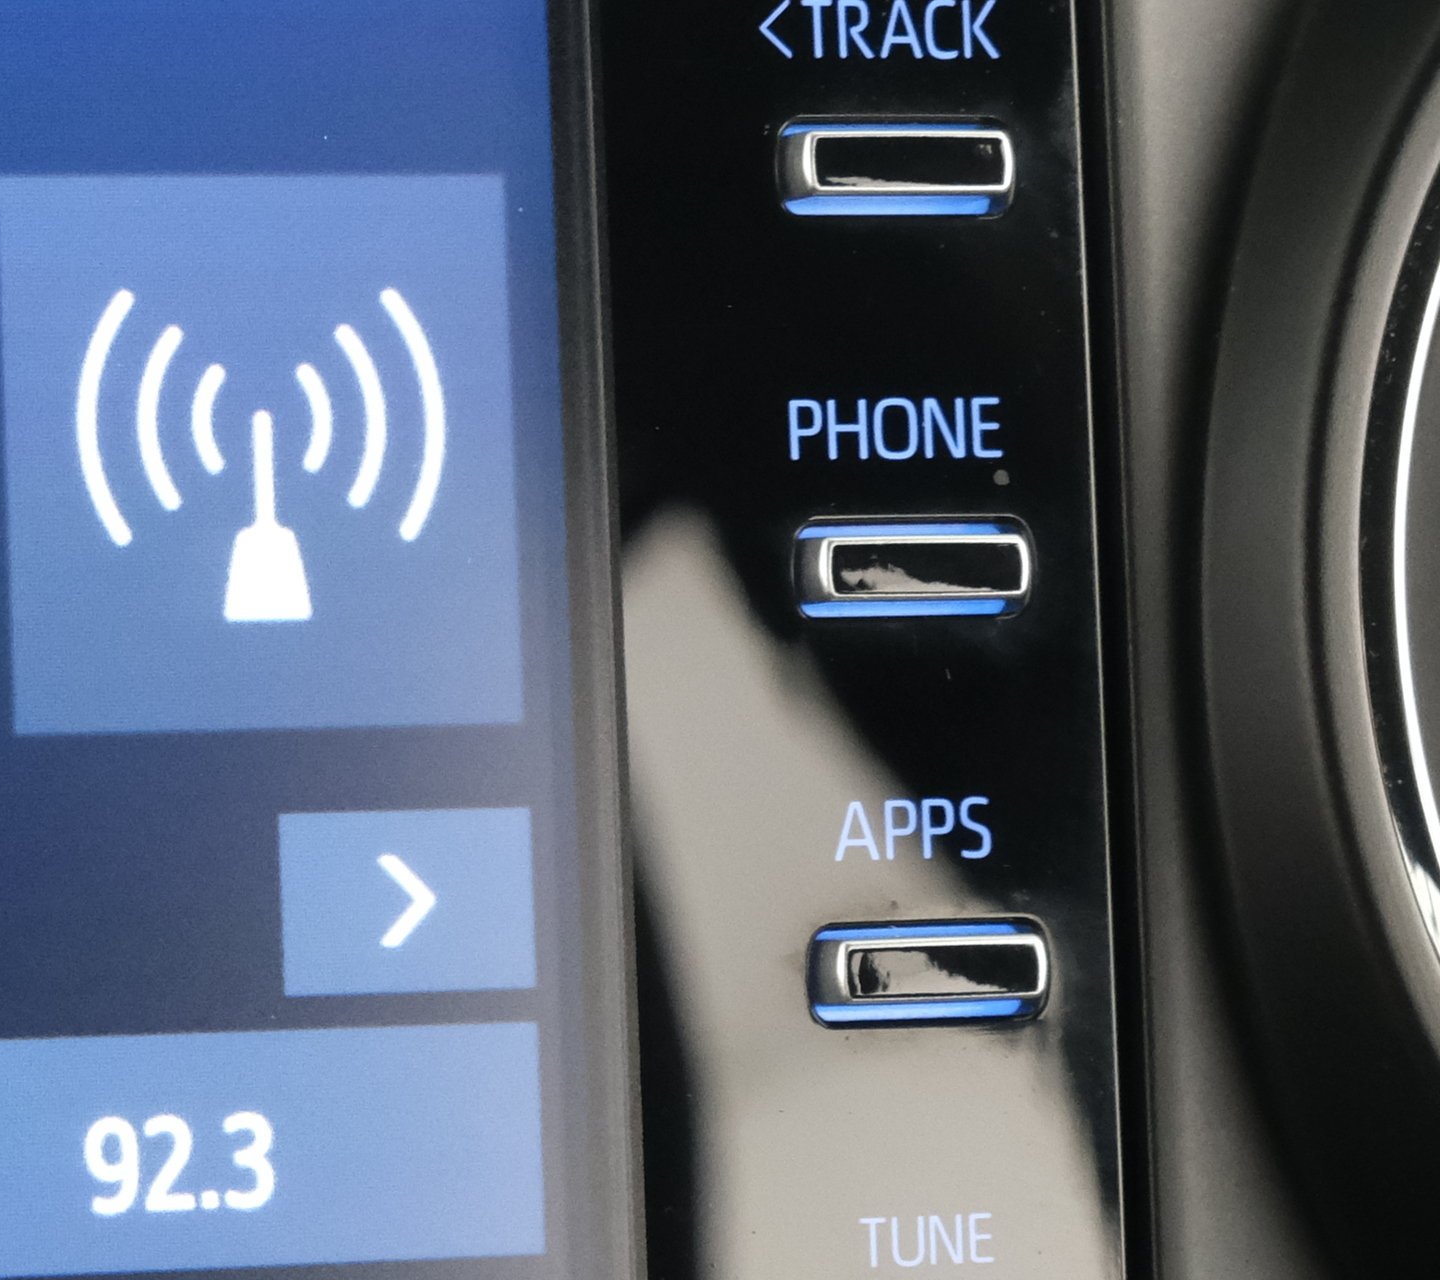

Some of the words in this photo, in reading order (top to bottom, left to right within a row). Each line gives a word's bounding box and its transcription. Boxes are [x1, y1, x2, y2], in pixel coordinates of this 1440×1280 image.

[787, 395, 1005, 462] PHONE
[834, 796, 993, 862] APPS
[82, 1109, 277, 1218] 92.3
[859, 1212, 995, 1268] TUNE
